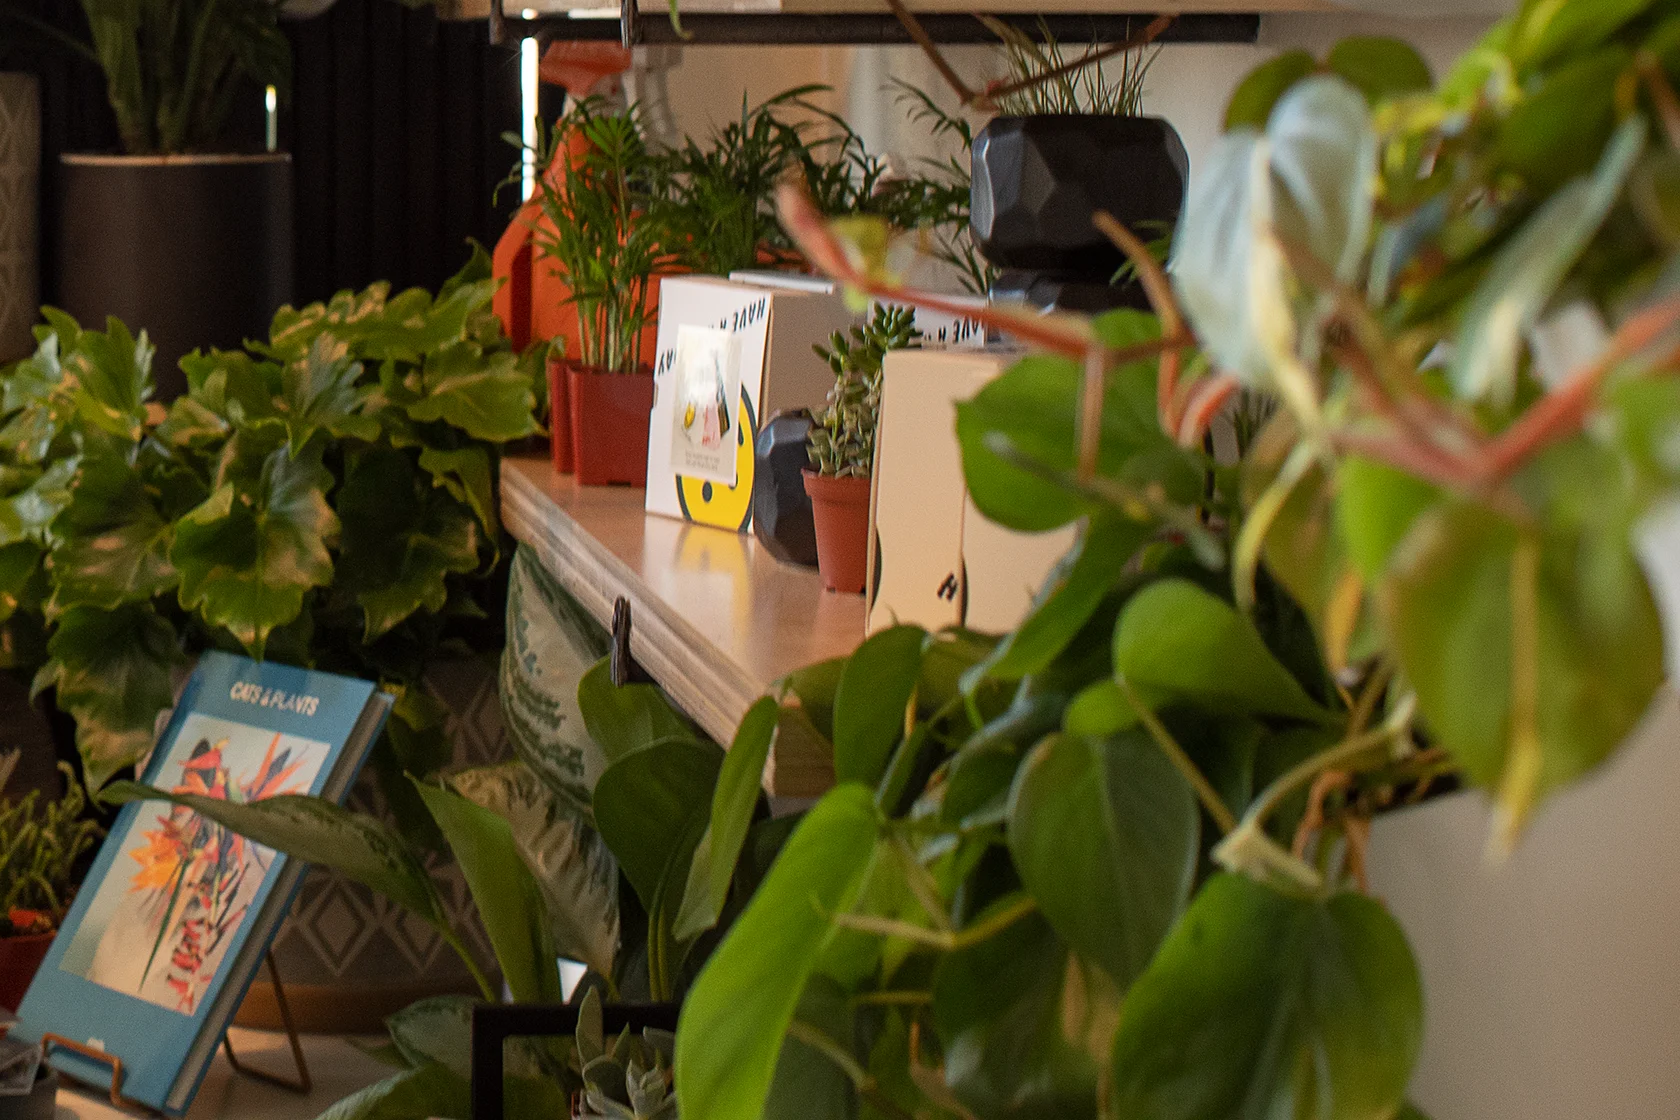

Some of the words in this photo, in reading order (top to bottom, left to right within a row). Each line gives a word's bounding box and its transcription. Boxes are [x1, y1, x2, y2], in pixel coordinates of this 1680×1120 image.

[732, 296, 766, 333] HAVE
[951, 315, 985, 345] AVE
[657, 347, 678, 377] AY
[229, 681, 263, 705] CATS
[270, 688, 321, 717] PLANTS
